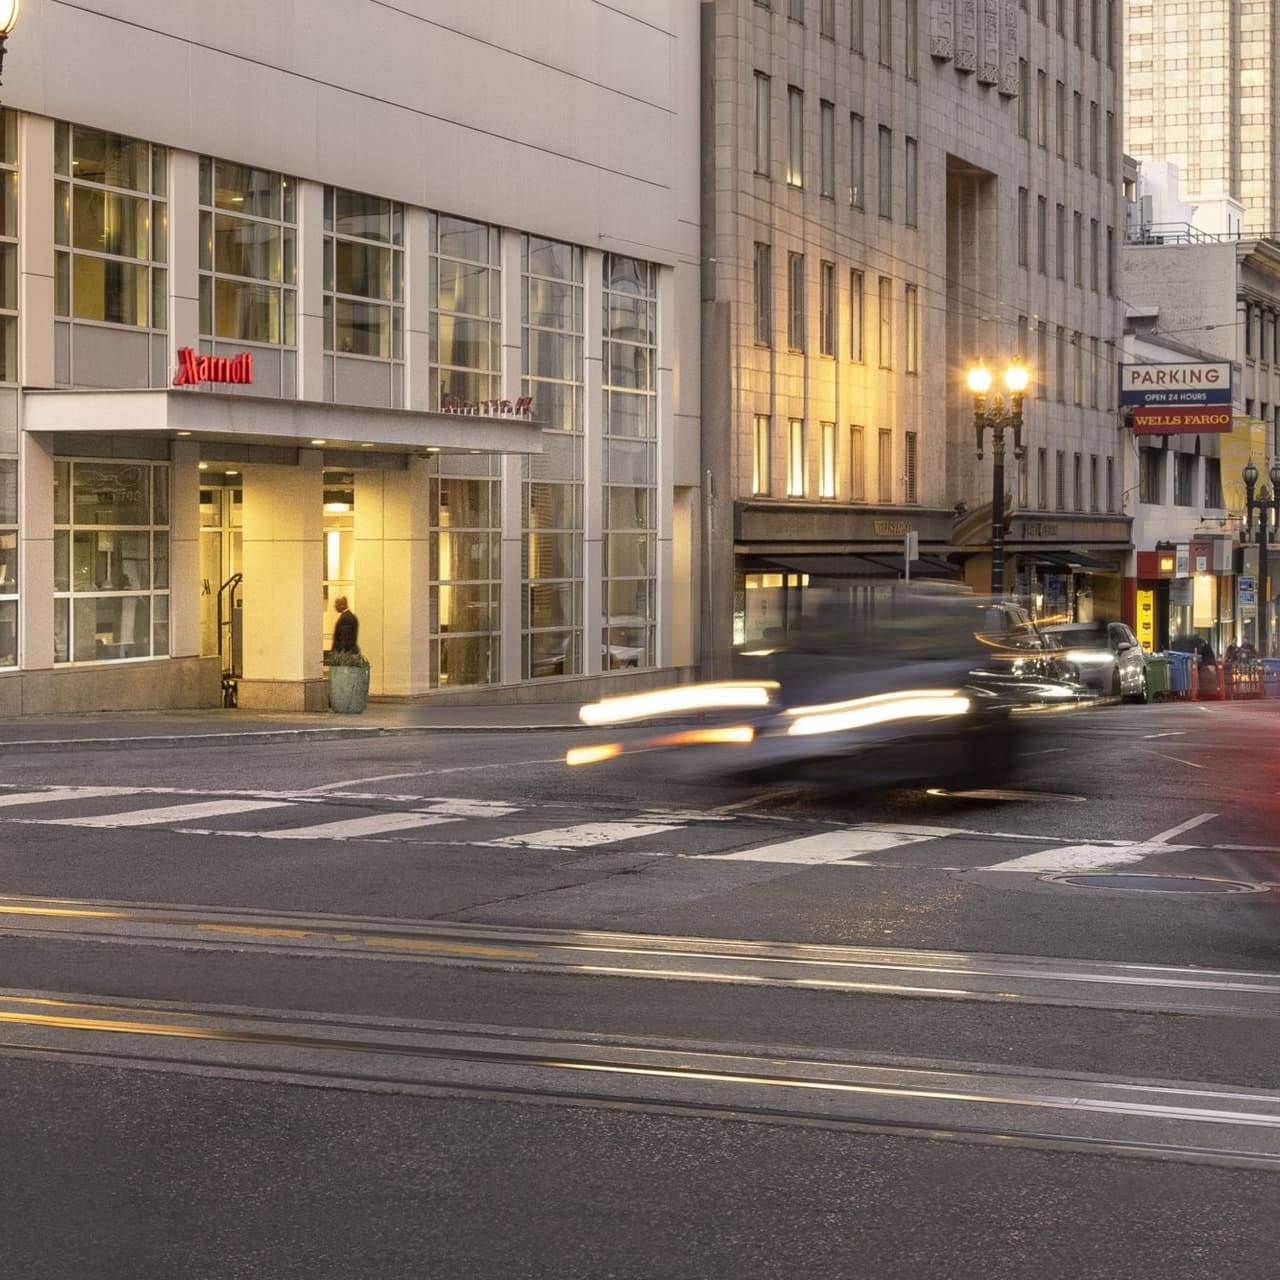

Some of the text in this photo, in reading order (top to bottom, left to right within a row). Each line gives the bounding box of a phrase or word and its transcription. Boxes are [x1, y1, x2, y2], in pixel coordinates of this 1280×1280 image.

[172, 346, 253, 386] Marriott
[1131, 369, 1220, 384] PARKING
[1136, 414, 1229, 425] WELLS FARGO
